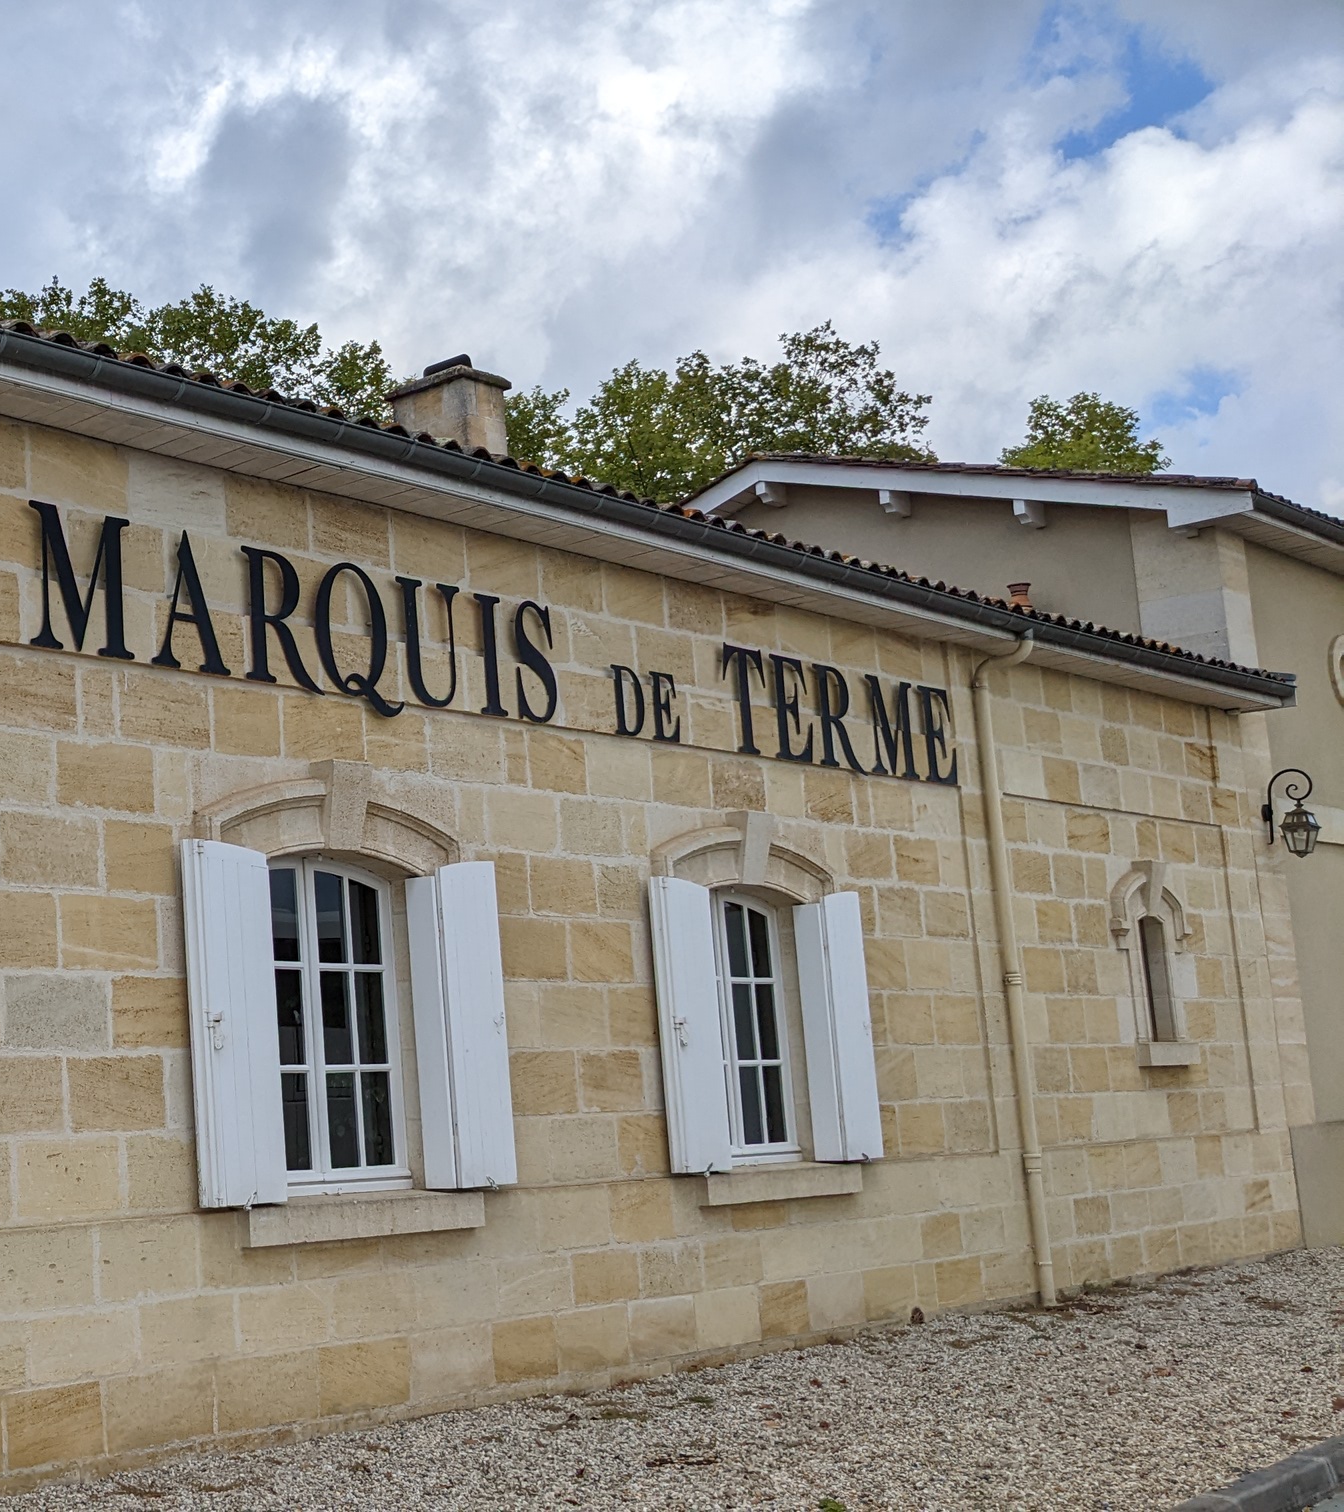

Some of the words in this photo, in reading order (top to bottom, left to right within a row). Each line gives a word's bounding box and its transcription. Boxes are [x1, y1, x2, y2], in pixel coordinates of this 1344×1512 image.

[29, 500, 558, 724] MARQUIS
[610, 664, 680, 743] DE
[722, 643, 958, 784] TERME
